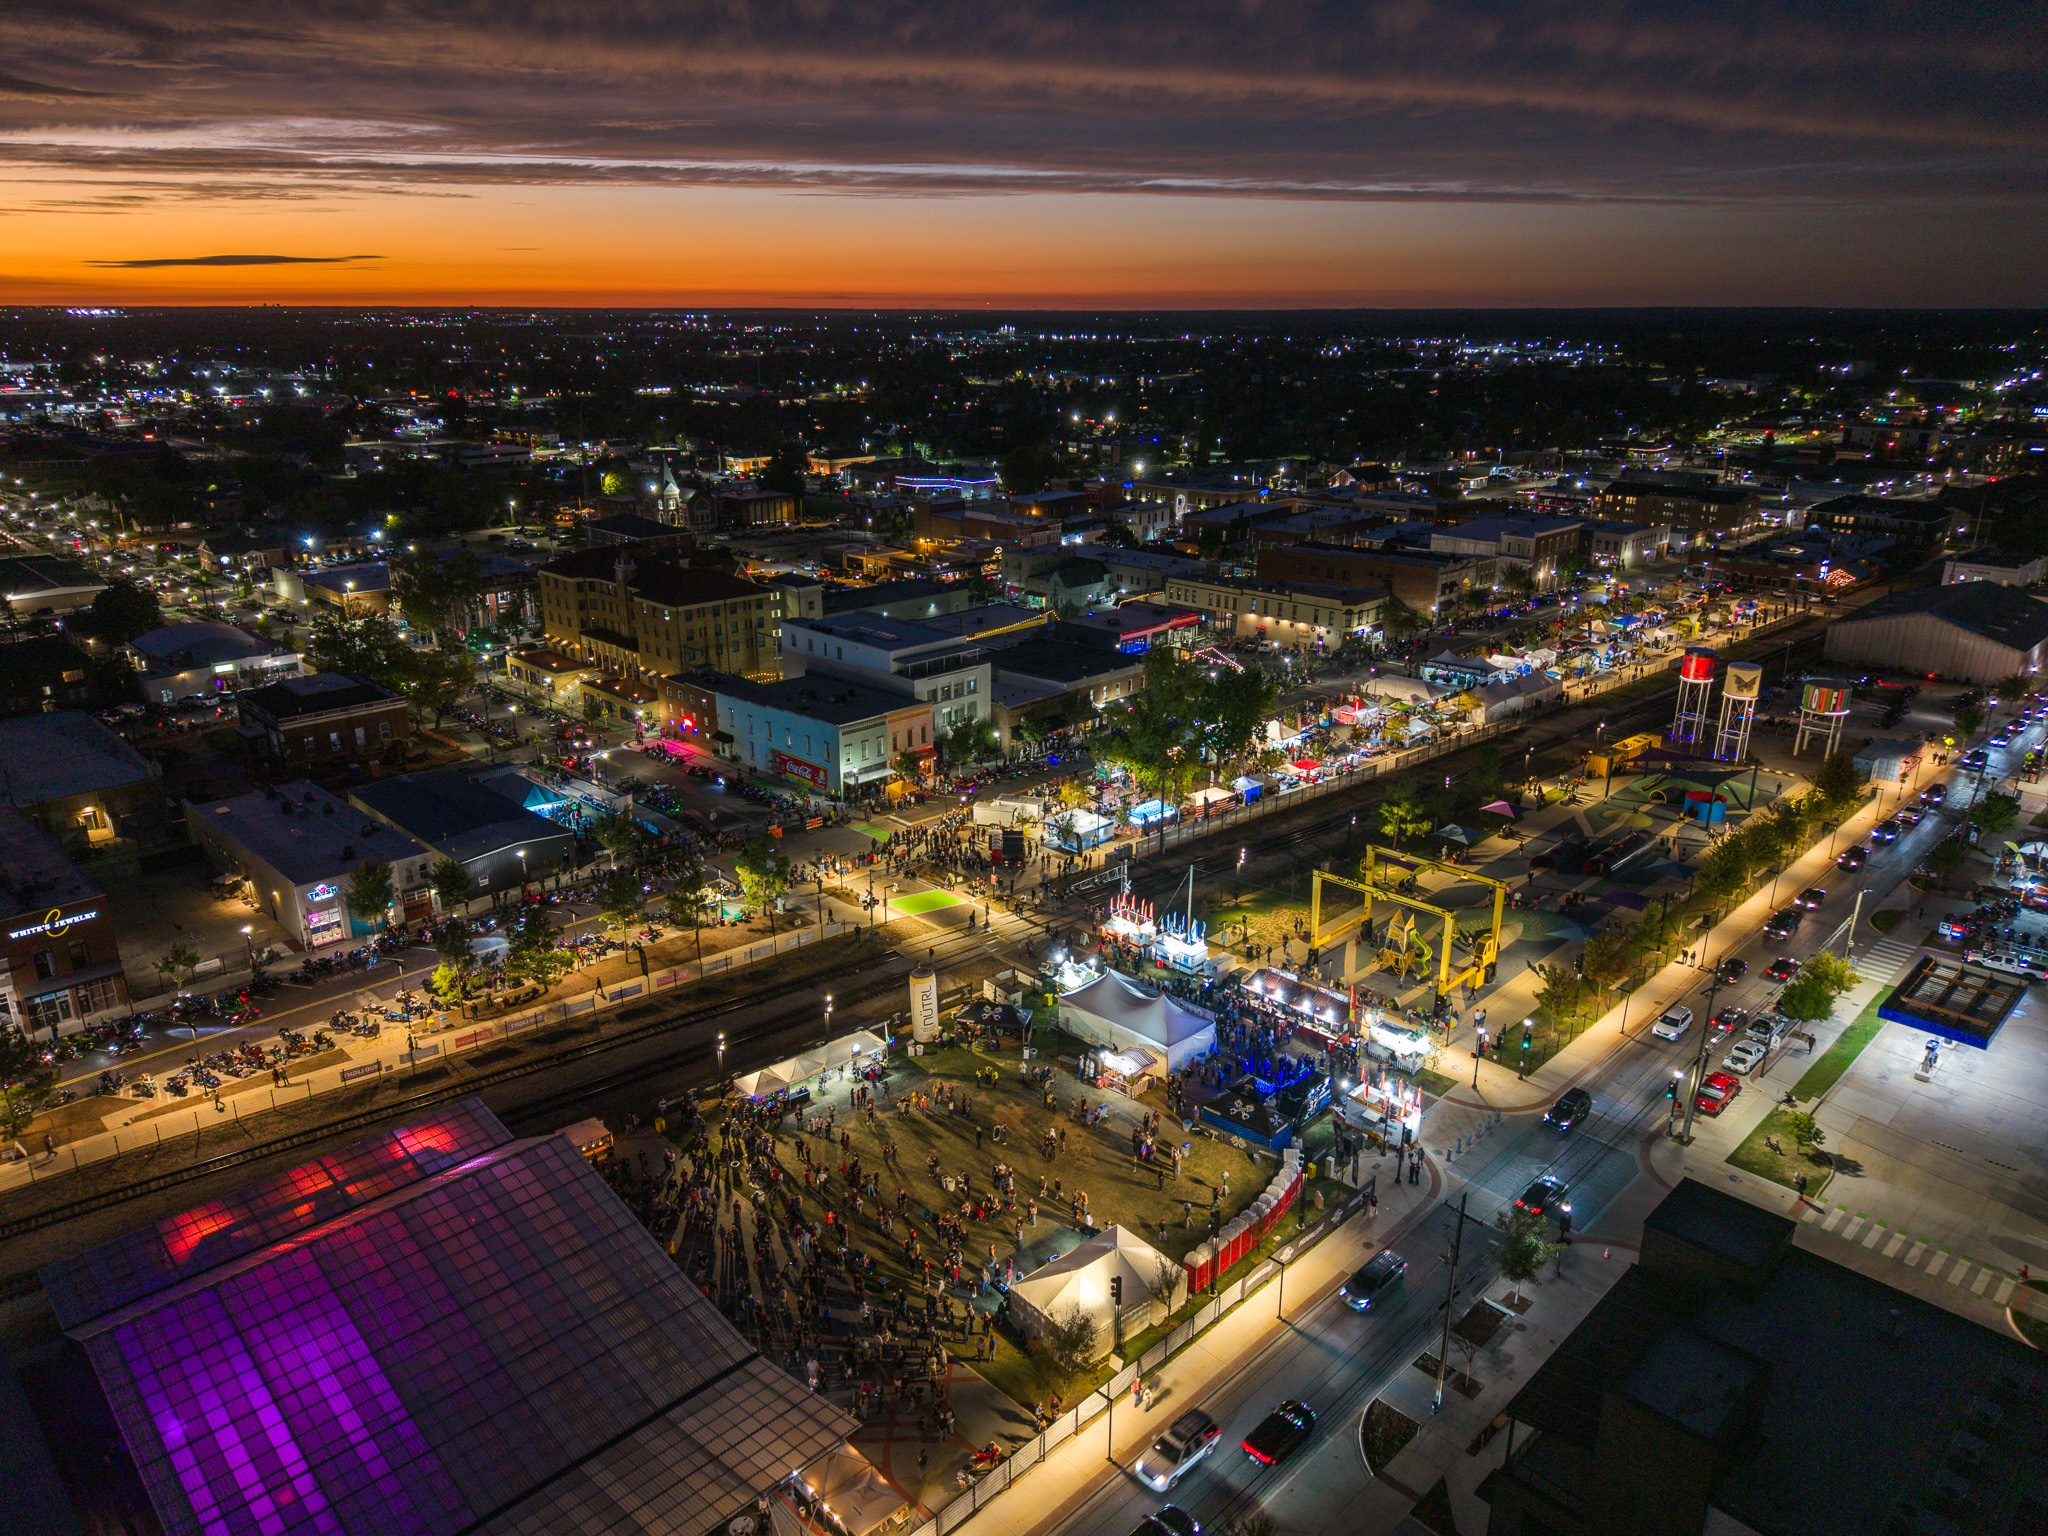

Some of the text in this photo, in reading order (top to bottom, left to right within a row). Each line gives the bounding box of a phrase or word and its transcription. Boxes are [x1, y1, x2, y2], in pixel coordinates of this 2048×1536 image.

[1426, 661, 1447, 669] OFFICIAL
[9, 911, 97, 939] WHITE'S JEWELRY
[920, 985, 934, 1027] NÜTRL
